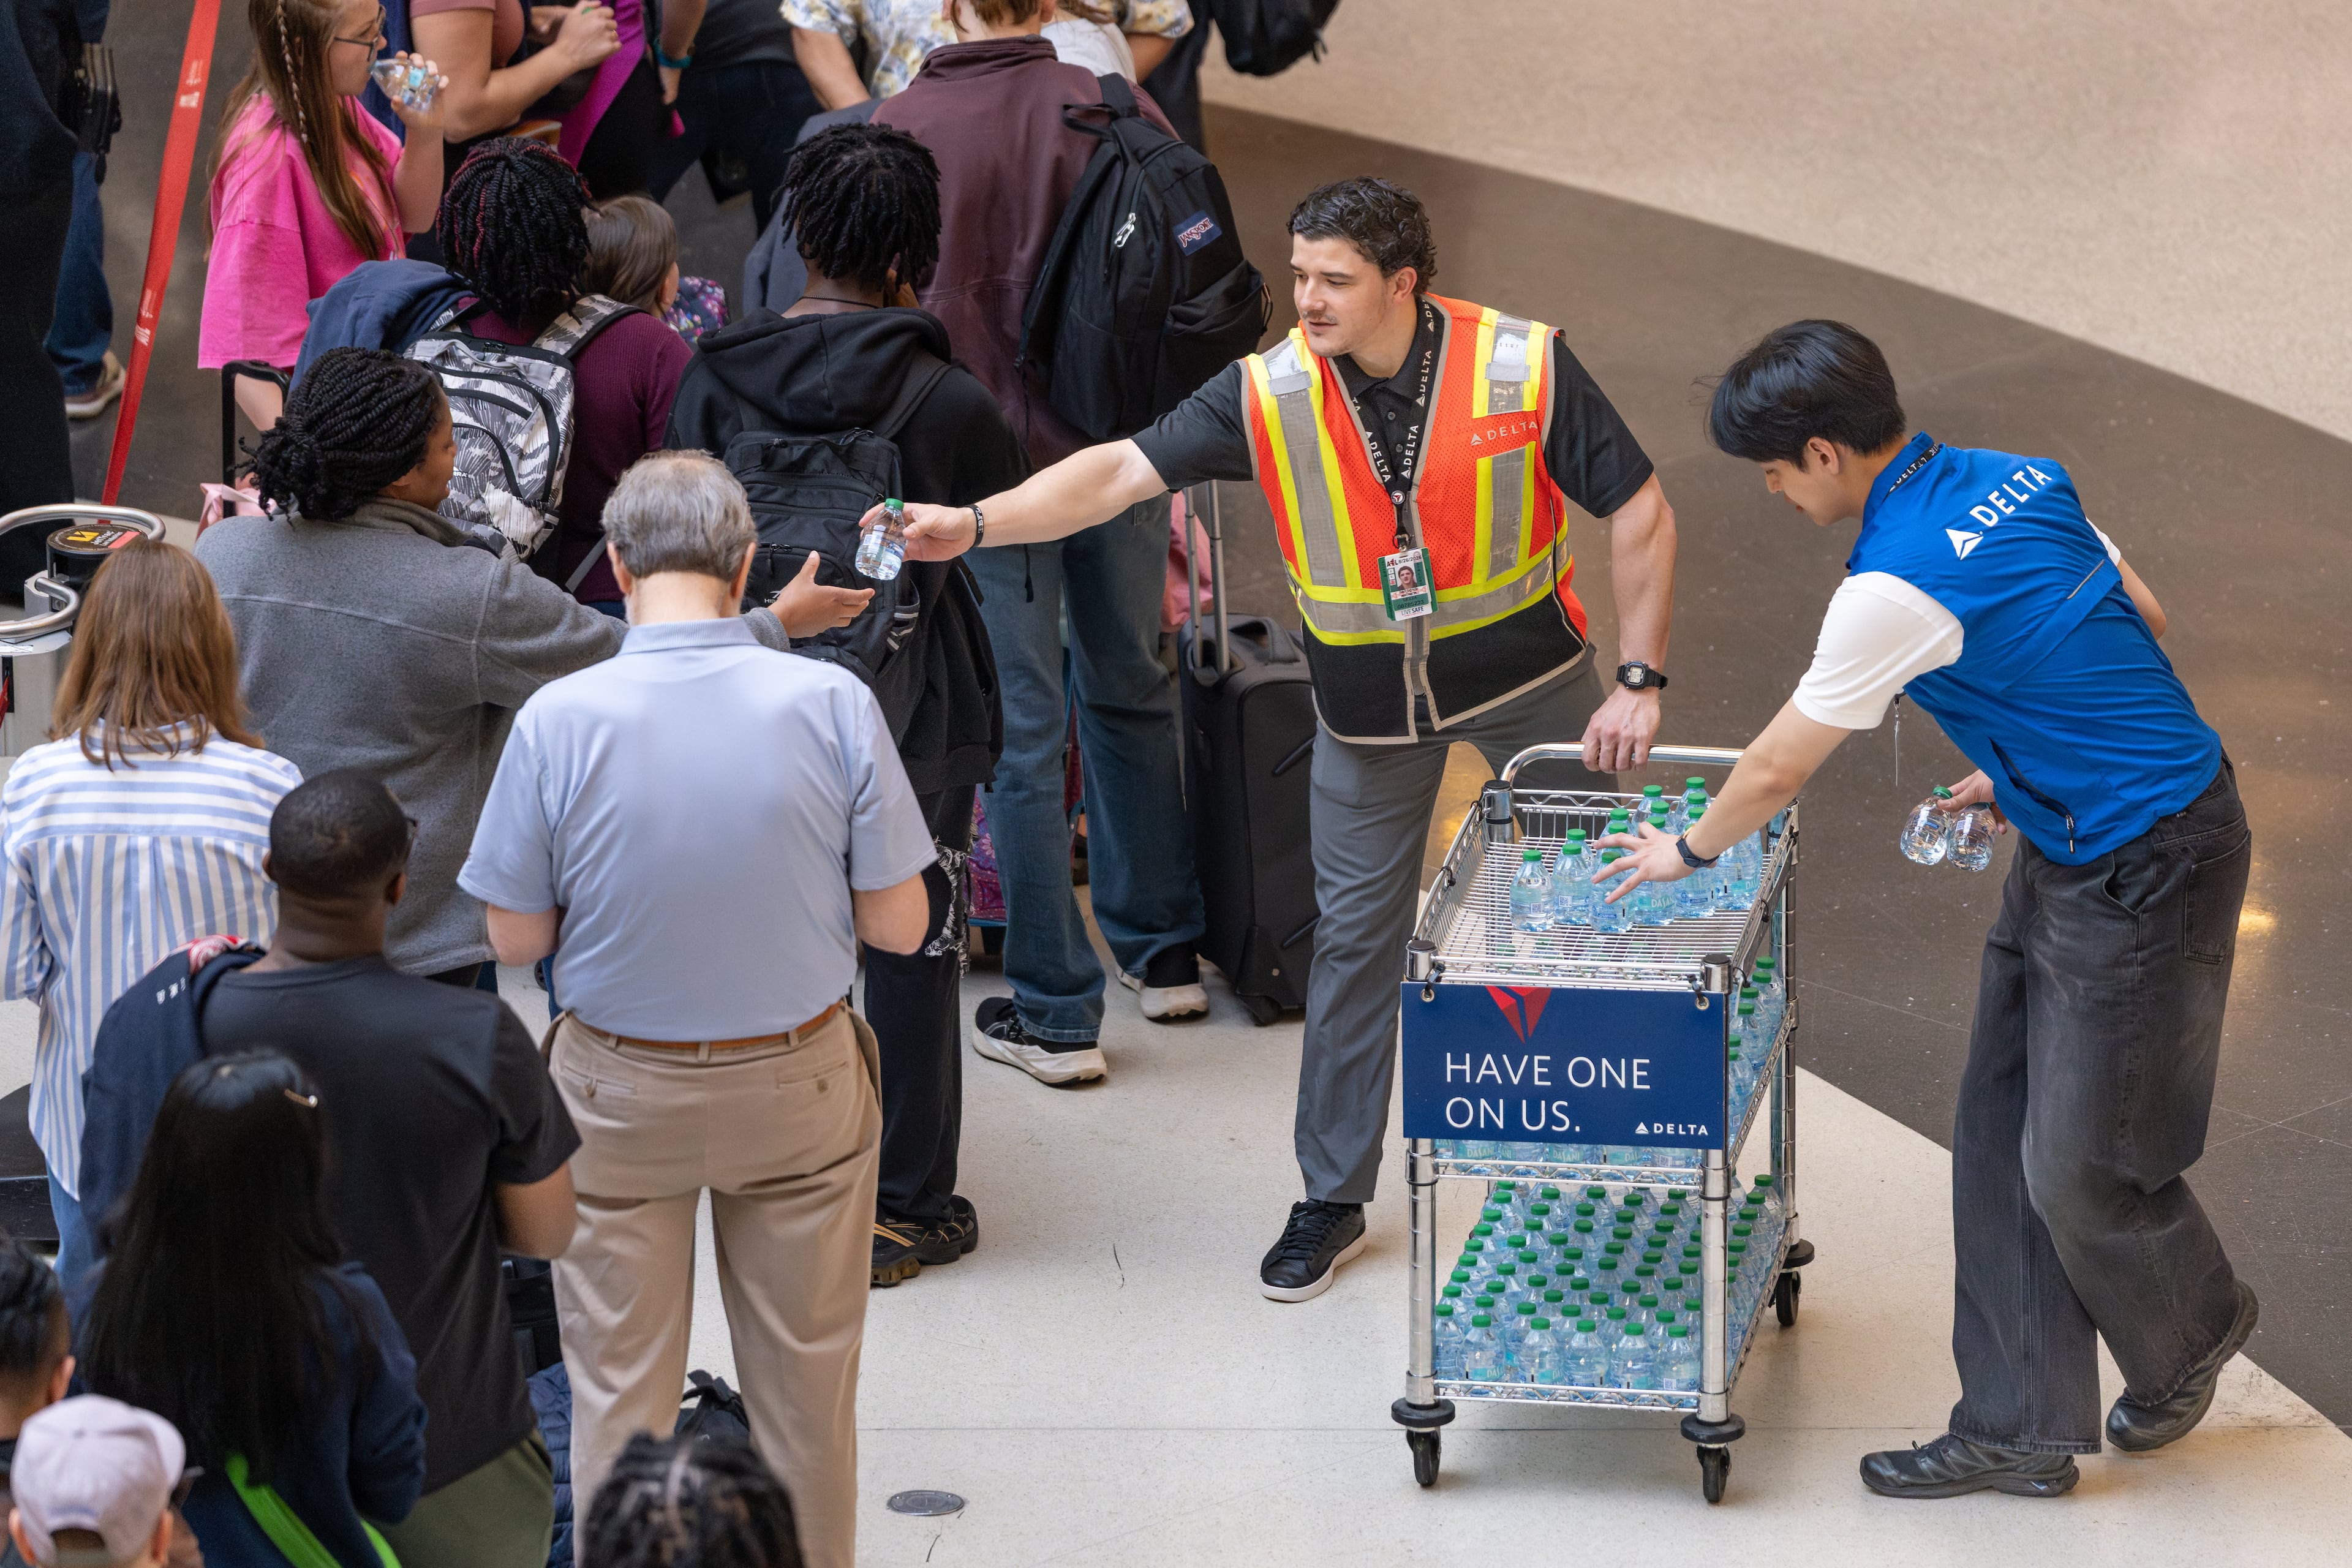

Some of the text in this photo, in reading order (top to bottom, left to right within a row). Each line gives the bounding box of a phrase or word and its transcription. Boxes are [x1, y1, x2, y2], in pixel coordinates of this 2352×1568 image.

[1178, 217, 1213, 247] JANSPORT
[1403, 425, 1419, 466] DELTA
[1487, 421, 1538, 440] DELTA
[1370, 442, 1392, 482] DELTA
[1896, 463, 1917, 484] DELT
[1969, 465, 2052, 527] DELTA
[1446, 1052, 1651, 1089] HAVE ONE
[1446, 1097, 1580, 1132] ON US.
[1654, 1123, 1708, 1136] DELTA
